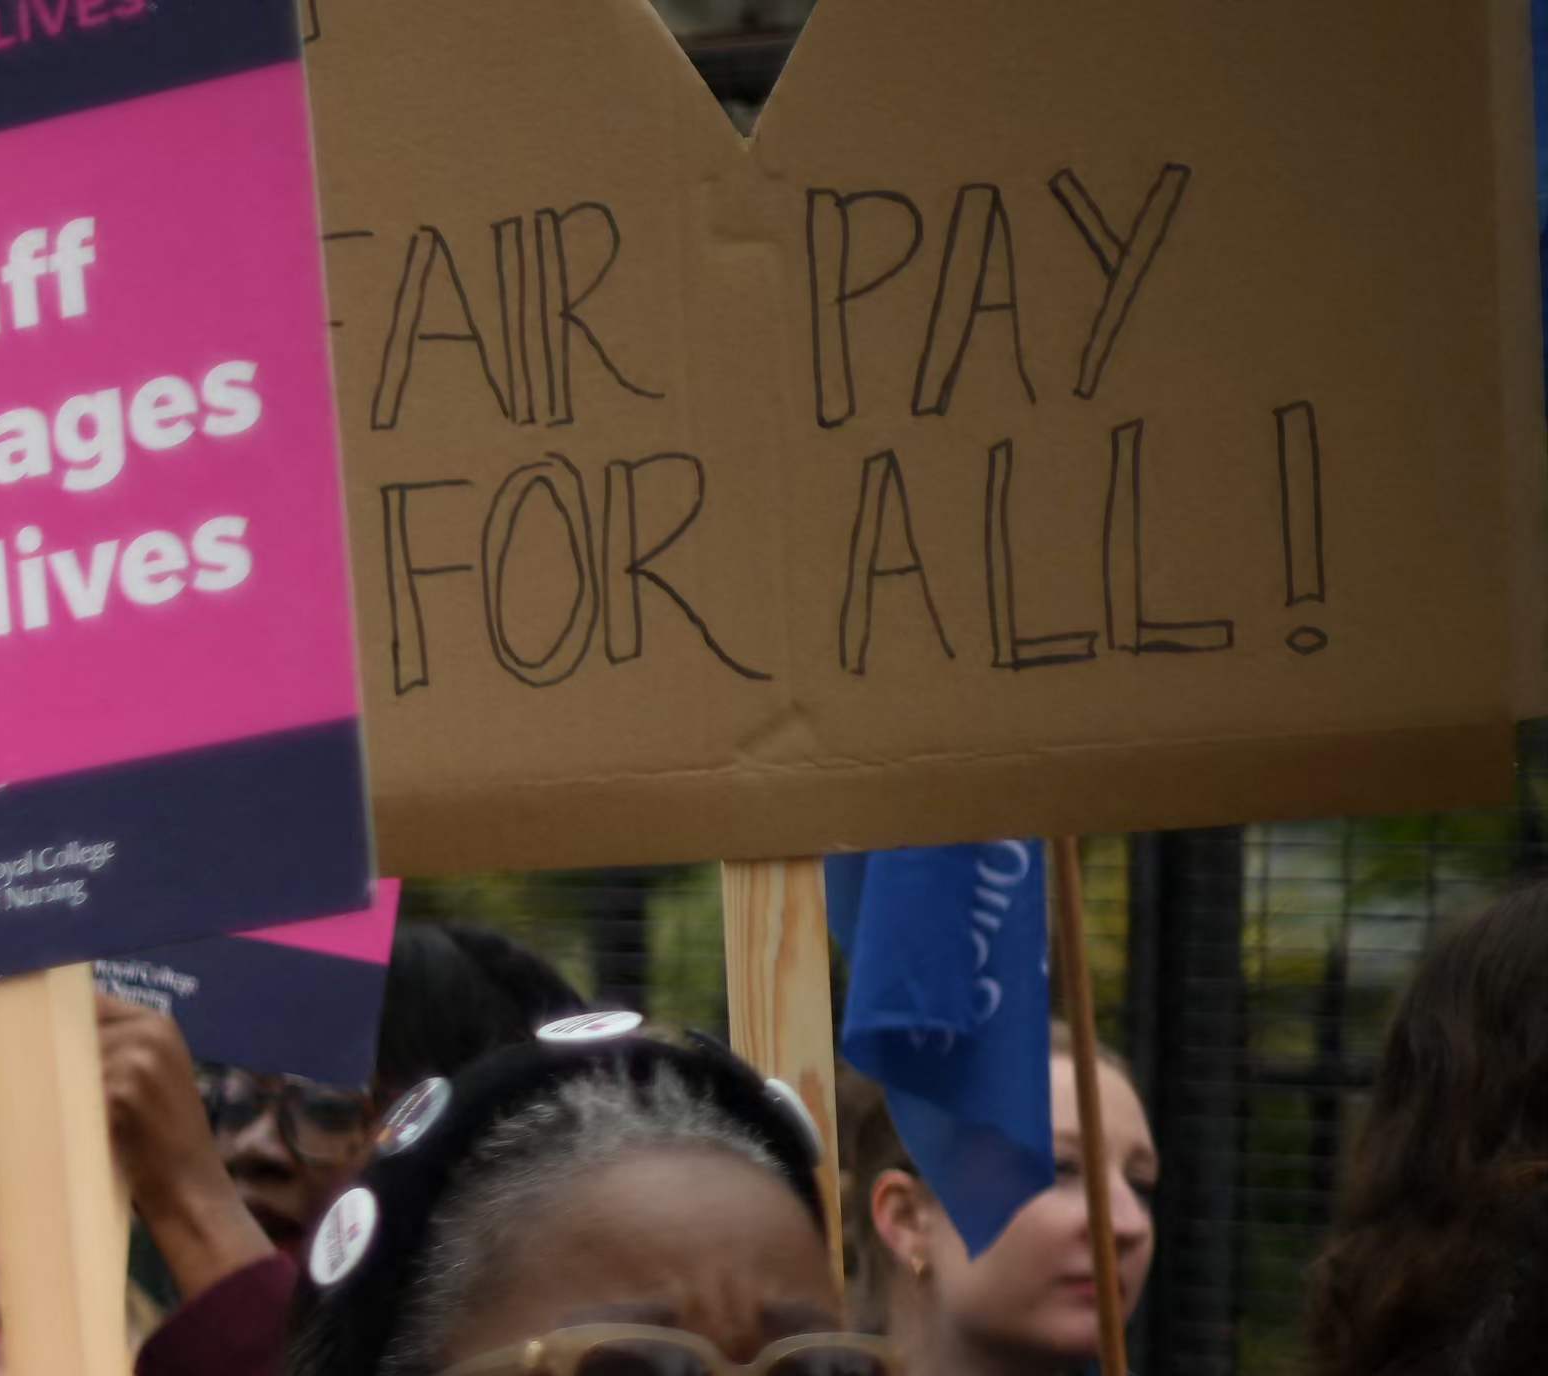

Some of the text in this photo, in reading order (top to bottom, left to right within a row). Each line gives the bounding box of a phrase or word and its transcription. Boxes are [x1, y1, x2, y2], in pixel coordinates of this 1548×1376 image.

[805, 162, 1192, 428] PAY
[380, 451, 773, 697] FOR
[4, 876, 88, 911] Nursing
[37, 837, 117, 877] College
